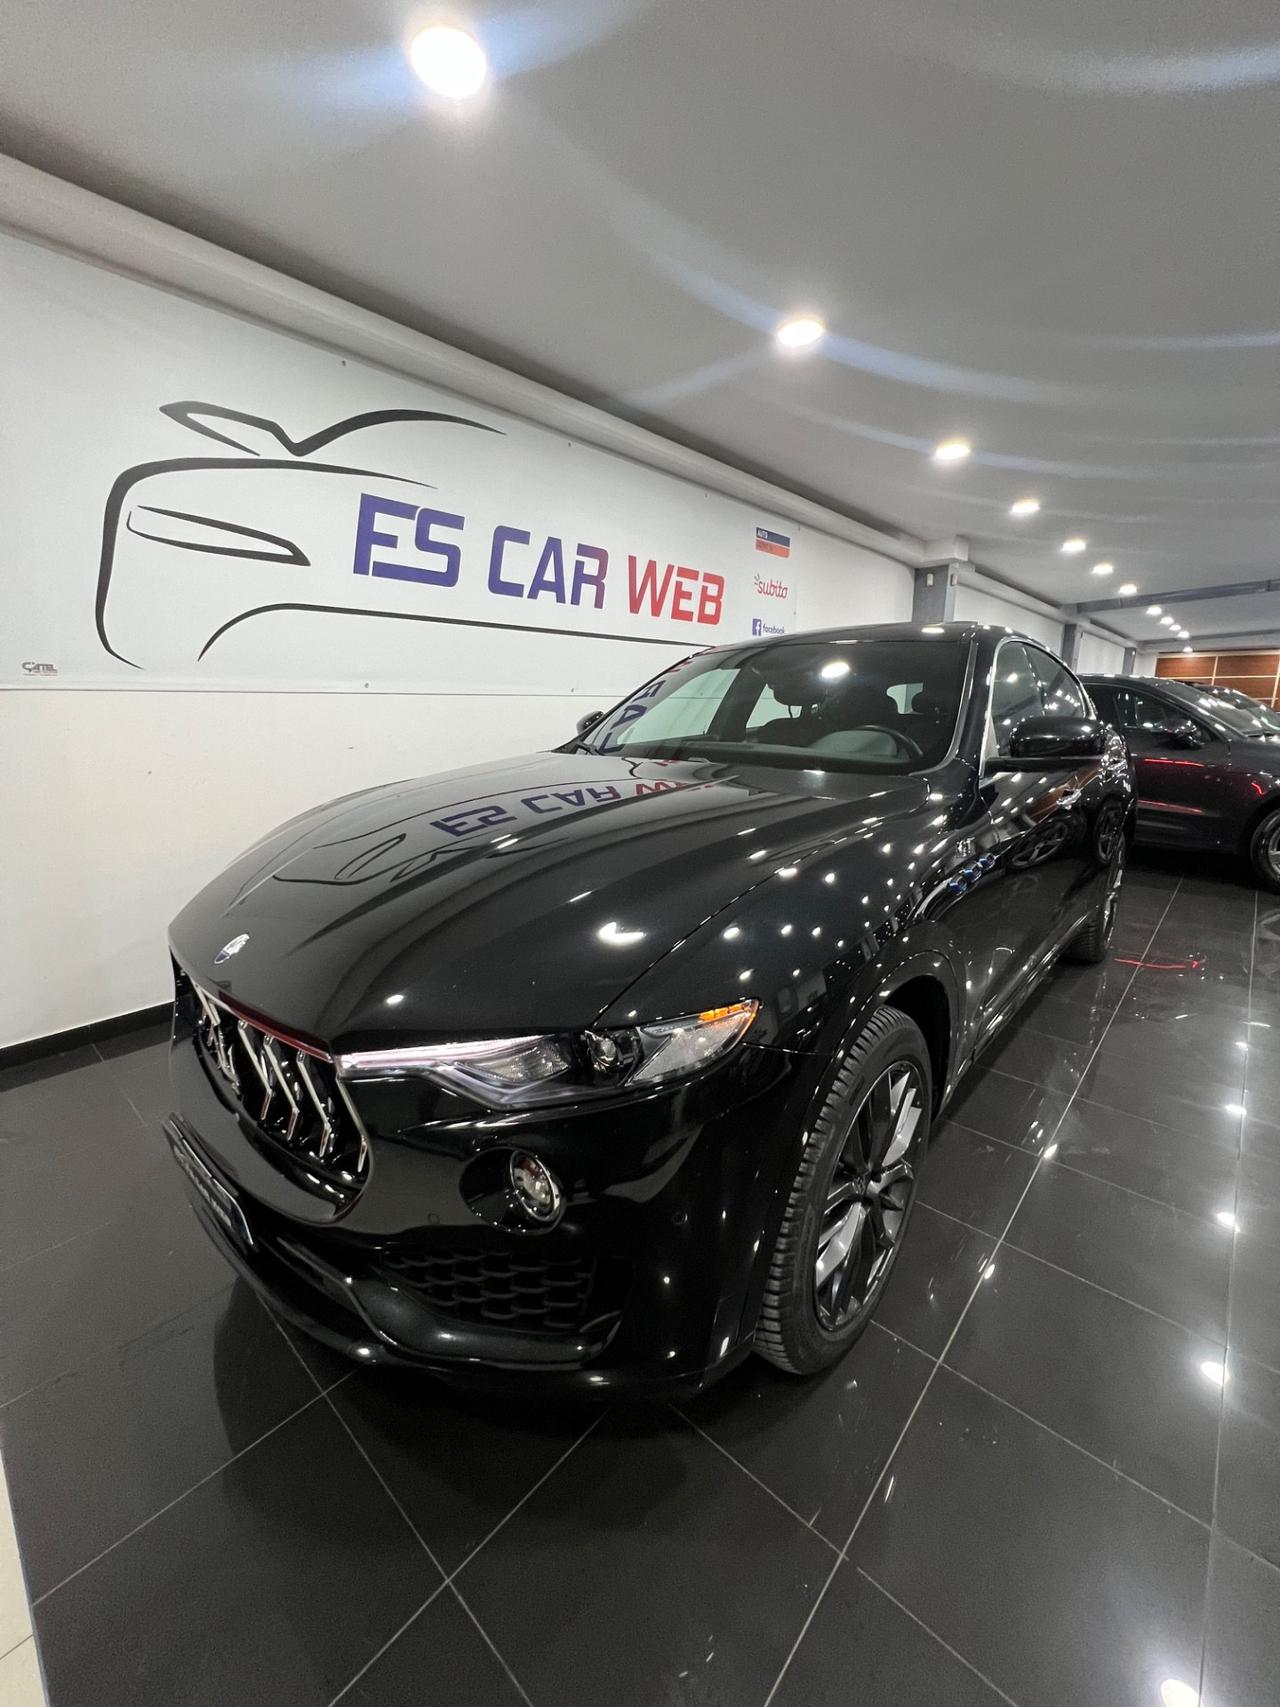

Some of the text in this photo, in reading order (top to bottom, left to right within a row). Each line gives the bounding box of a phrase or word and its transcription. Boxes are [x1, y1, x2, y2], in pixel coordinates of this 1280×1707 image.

[353, 493, 725, 625] ES CAR WEB
[757, 579, 788, 599] subito
